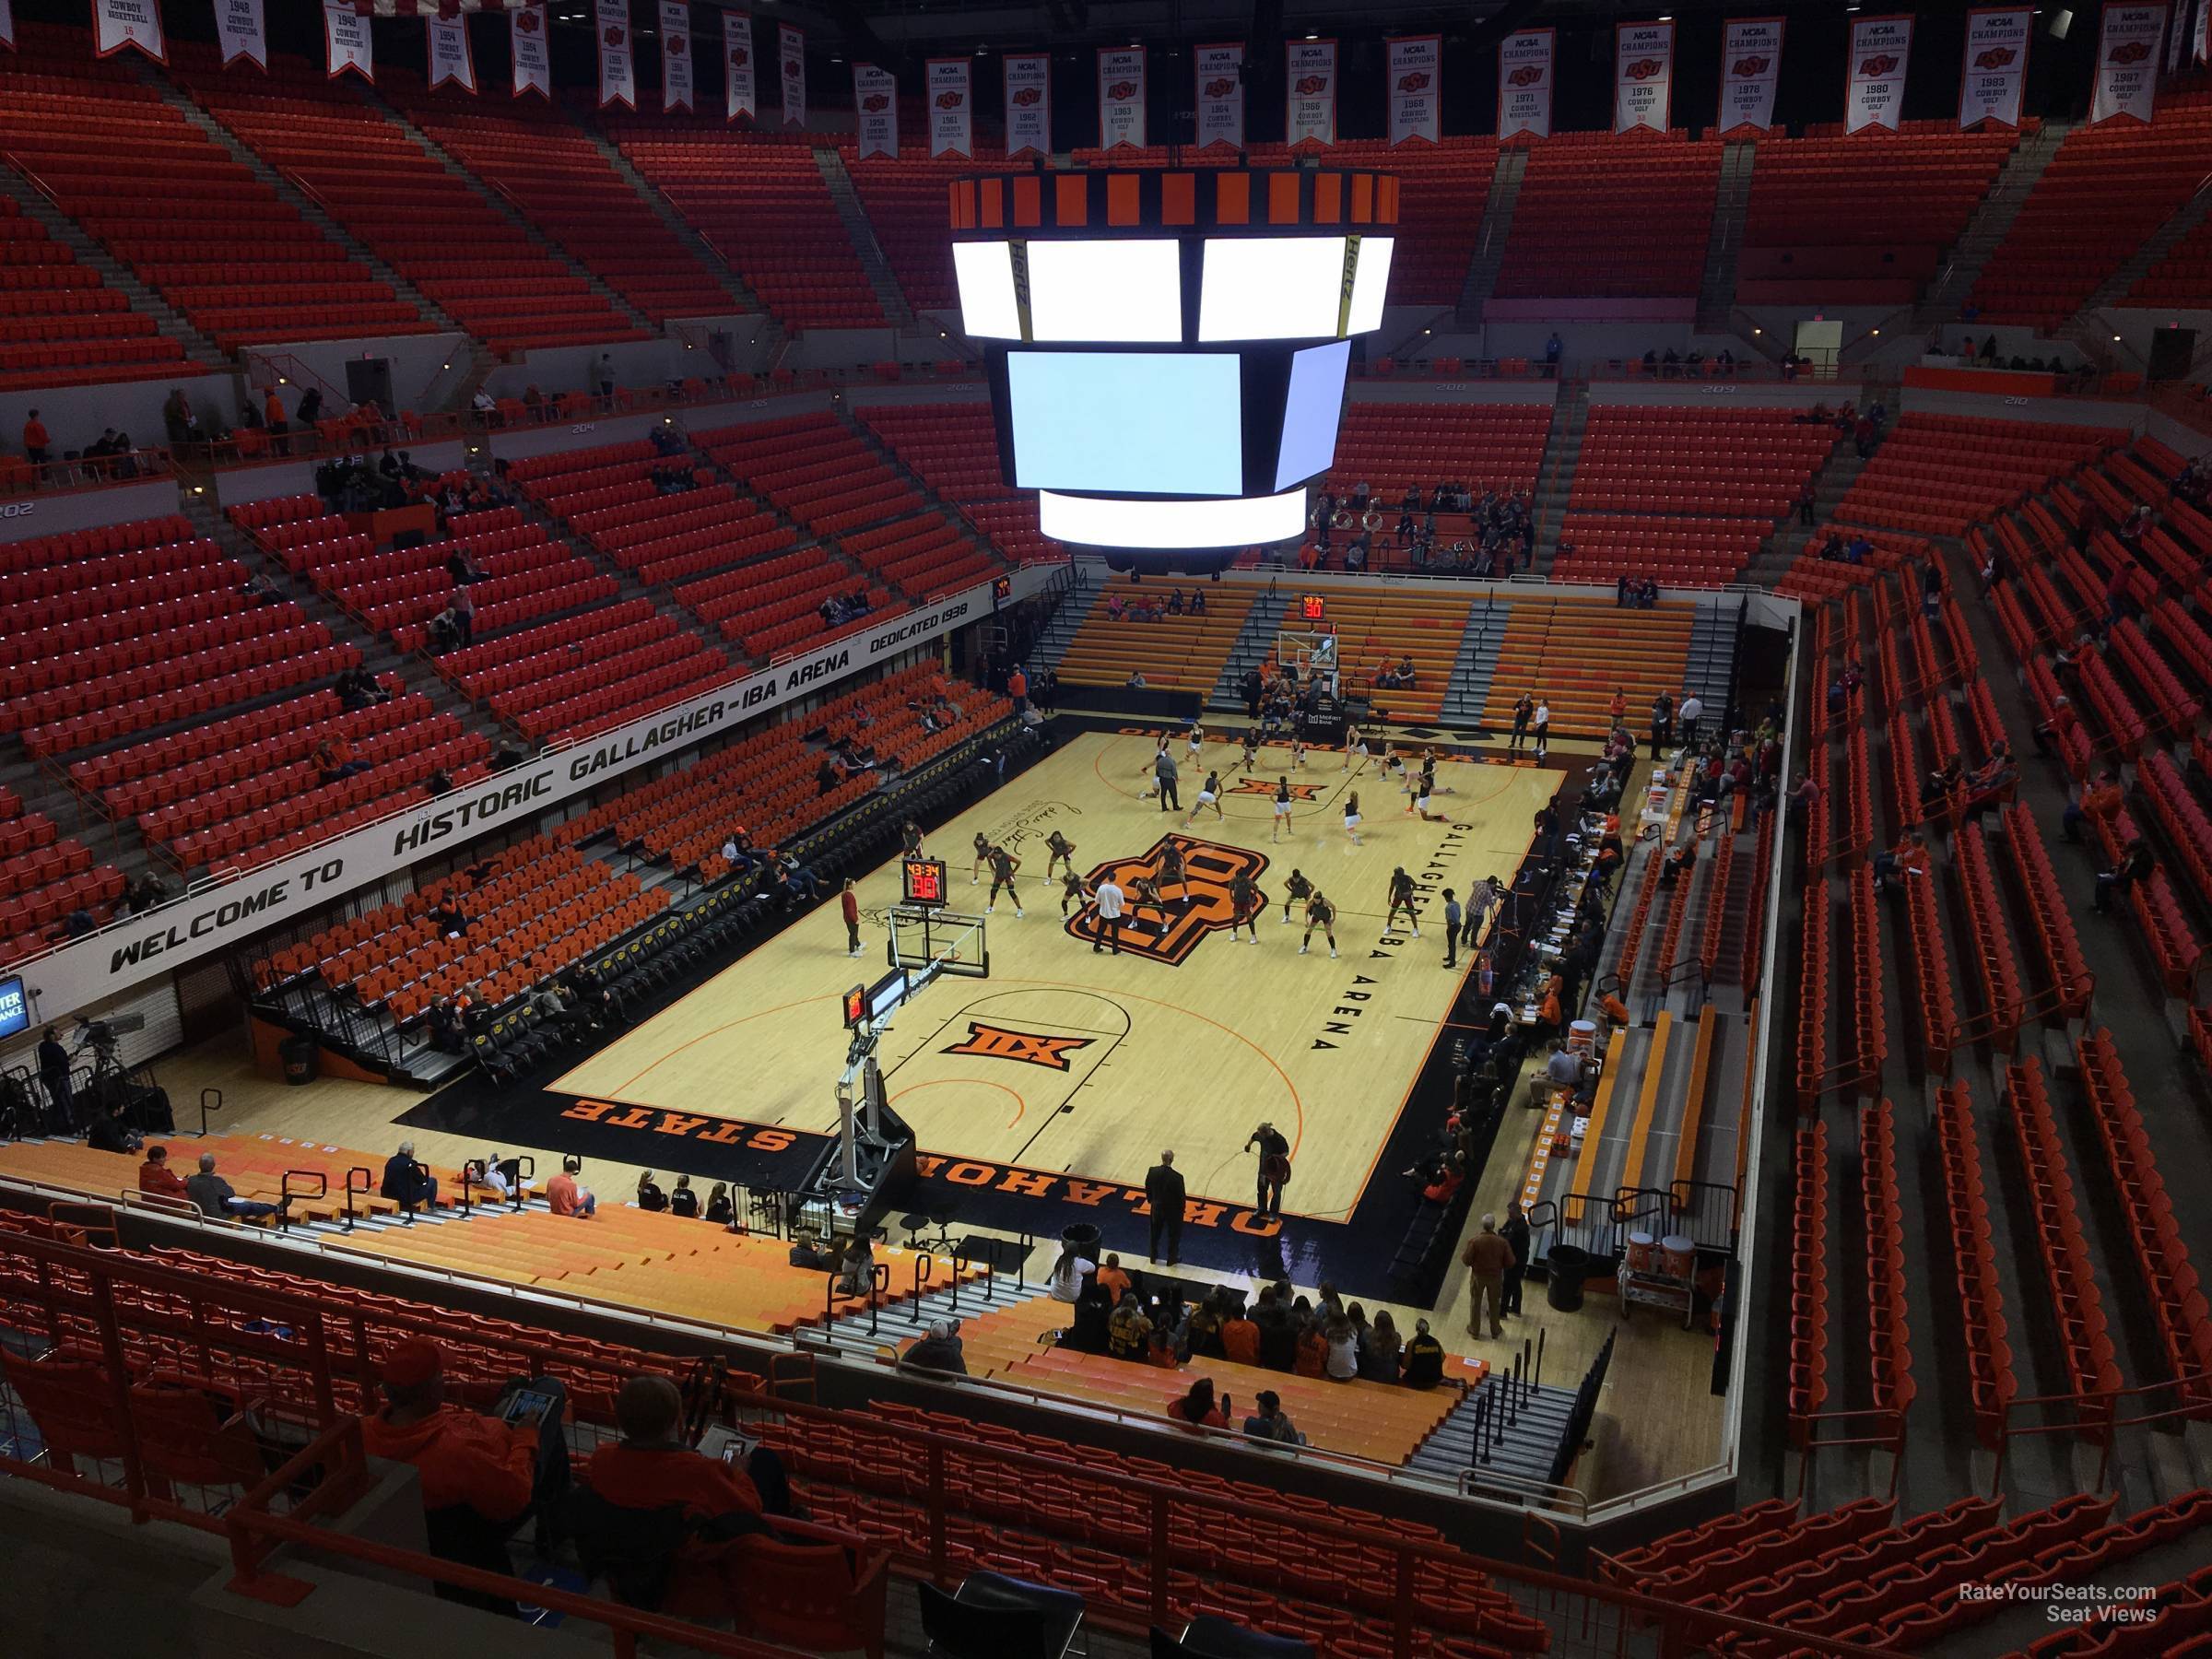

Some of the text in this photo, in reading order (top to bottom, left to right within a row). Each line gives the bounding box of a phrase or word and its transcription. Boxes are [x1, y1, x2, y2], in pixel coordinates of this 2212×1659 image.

[109, 0, 141, 13] COWBOY
[229, 0, 250, 14] 1948
[108, 10, 148, 24] BASKETBALL
[597, 6, 628, 19] CHAMPIONS
[2121, 12, 2150, 21] NCAA
[228, 14, 254, 27] COWBOY
[337, 14, 357, 27] 1949
[1985, 18, 2013, 27] NCAA
[1741, 28, 1767, 37] NCAA
[1868, 26, 1895, 35] NCAA
[2107, 23, 2161, 33] CHAMPIONS
[336, 29, 360, 40] COWBOY
[440, 29, 456, 41] 1954
[1632, 31, 1659, 41] NCAA
[1971, 29, 2025, 40] CHAMPIONS
[335, 37, 363, 48] WRESTLING
[1515, 39, 1539, 48] NCAA
[1621, 41, 1669, 52] CHAMPIONS
[1729, 38, 1778, 48] CHAMPIONS
[1856, 36, 1907, 47] CHAMPIONS
[1300, 49, 1323, 58] NCAA
[1403, 45, 1426, 55] NCAA
[1503, 48, 1549, 59] CHAMPIONS
[1112, 56, 1132, 65] NCAA
[1209, 53, 1230, 61] NCAA
[1393, 54, 1436, 65] CHAMPIONS
[1973, 47, 2018, 70] OSU
[1017, 63, 1037, 71] NCAA
[1199, 62, 1239, 71] CHAMPIONS
[1290, 58, 1332, 68] CHAMPIONS
[1732, 55, 1771, 77] OSU
[1858, 54, 1900, 77] OSU
[865, 70, 884, 78] NCAA
[1102, 65, 1142, 75] CHAMPIONS
[1624, 58, 1663, 80] OSU
[930, 76, 967, 84] CHAMPIONS
[1007, 72, 1046, 81] CHAMPIONS
[1508, 65, 1545, 87] OSU
[2113, 73, 2139, 83] 1987
[857, 78, 893, 88] CHAMPIONS
[1295, 75, 1327, 95] OSU
[1397, 72, 1431, 92] OSU
[1981, 77, 2005, 88] 1983
[1107, 81, 1137, 100] OSU
[1204, 77, 1236, 99] OSU
[1631, 87, 1653, 97] 1976
[1738, 85, 1760, 94] 1978
[1865, 84, 1888, 94] 1980
[1975, 88, 2007, 98] COWBOY
[2109, 84, 2143, 92] COWBOY
[935, 91, 964, 110] OSU
[1012, 88, 1042, 107] OSU
[1515, 94, 1535, 103] 1971
[1628, 98, 1656, 106] COWBOY
[1733, 95, 1763, 104] COWBOY
[1861, 95, 1891, 104] COWBOY
[1983, 96, 1998, 104] GOLF
[1300, 102, 1321, 112] 1966
[1404, 100, 1424, 109] 1968
[1511, 104, 1538, 112] COWBOY
[1740, 102, 1755, 111] GOLF
[1113, 107, 1132, 116] 1963
[1298, 112, 1324, 120] COWBOY
[1401, 110, 1427, 118] COWBOY
[1509, 111, 1541, 119] WRESTLING
[942, 116, 958, 124] 1961
[1019, 113, 1037, 122] 1962
[1399, 116, 1430, 124] WRESTLING
[1013, 242, 1029, 305] Hertz
[1345, 239, 1359, 300] Hertz
[572, 423, 594, 434] 204
[0, 503, 34, 518] 02
[1304, 596, 1324, 605] 43:34
[1306, 605, 1322, 617] 30
[110, 879, 290, 973] WELCOME
[300, 859, 343, 891] TO
[394, 769, 554, 856] HISTORIC
[785, 650, 849, 691] ARENA
[870, 614, 939, 653] DEDICATED
[941, 603, 968, 623] 1938
[907, 864, 939, 876] 43:34
[0, 992, 21, 1010] TER
[1311, 975, 1379, 1050] ARENA
[560, 1099, 796, 1152] STATE
